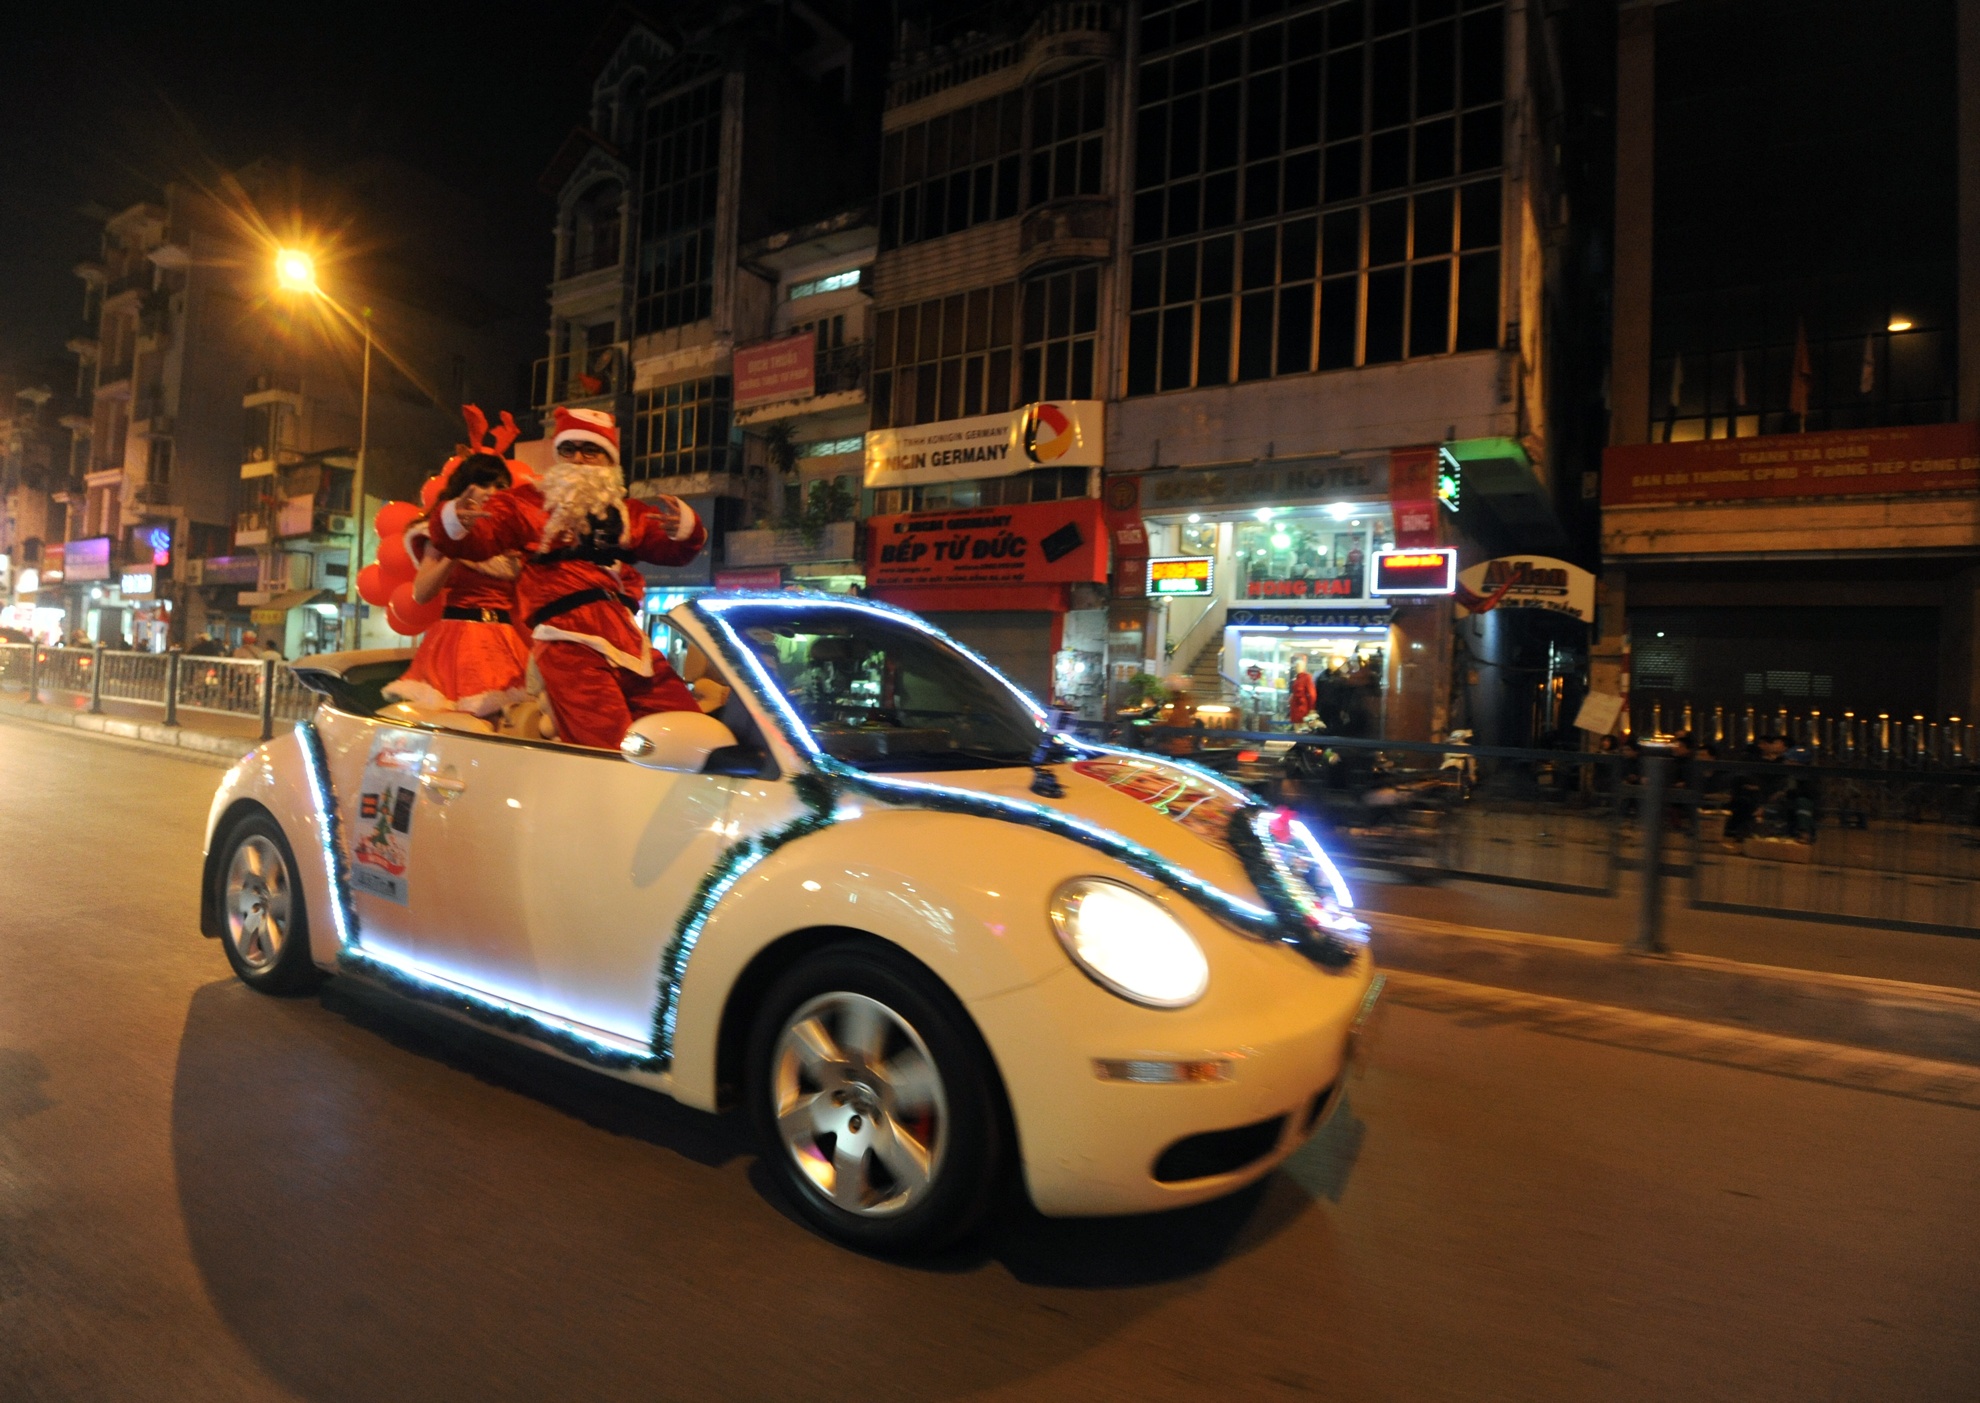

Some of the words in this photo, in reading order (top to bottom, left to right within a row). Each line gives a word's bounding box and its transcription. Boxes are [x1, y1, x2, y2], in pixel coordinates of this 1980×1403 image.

[930, 443, 1010, 468] GERMANY
[880, 534, 928, 564] BẾP
[971, 530, 1028, 560] ĐỨC
[1247, 580, 1308, 597] HONG
[1314, 578, 1352, 596] HAI
[1259, 613, 1307, 626] HONG
[1310, 614, 1345, 626] HAI
